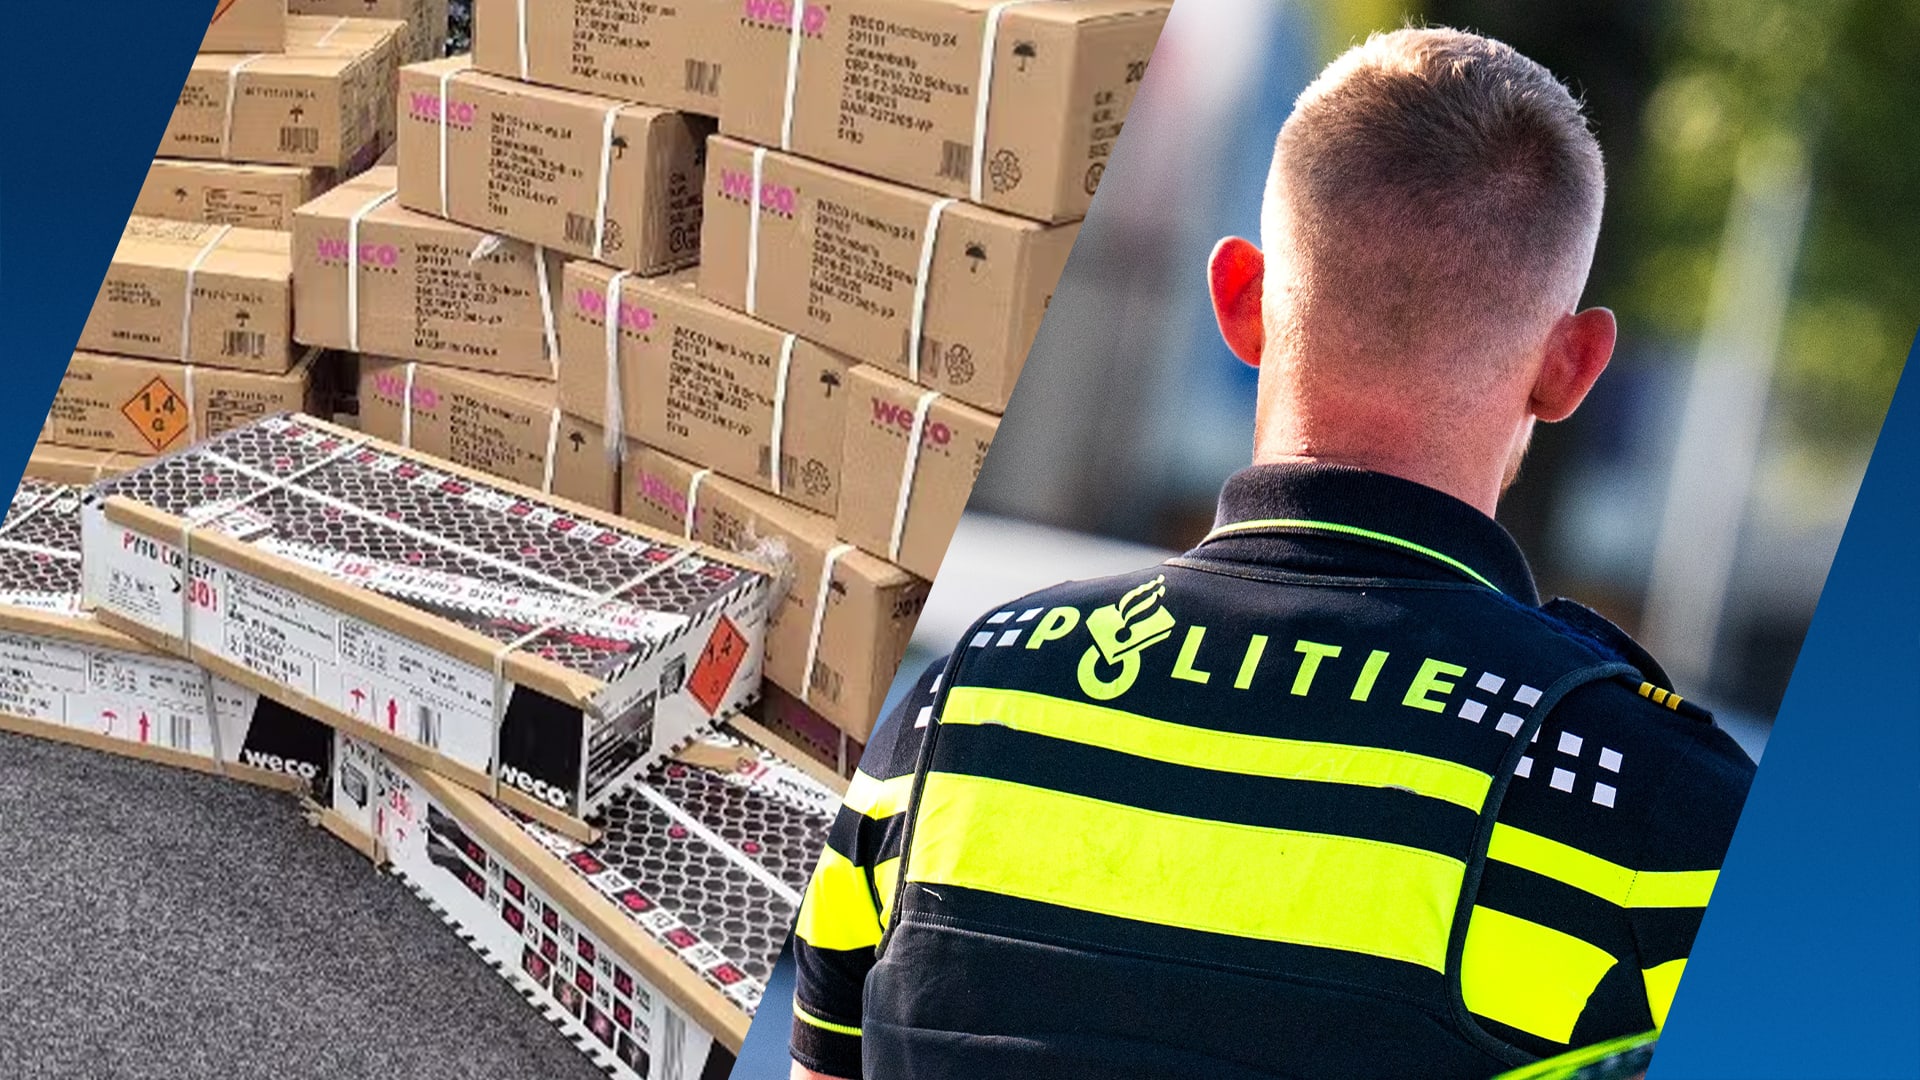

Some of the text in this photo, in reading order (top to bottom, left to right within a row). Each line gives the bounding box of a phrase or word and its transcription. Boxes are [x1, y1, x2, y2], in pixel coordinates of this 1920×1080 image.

[141, 392, 176, 415] 1.4
[152, 418, 165, 432] G
[1024, 574, 1468, 714] POLITIE
[244, 749, 317, 778] weco
[500, 763, 568, 807] weco
